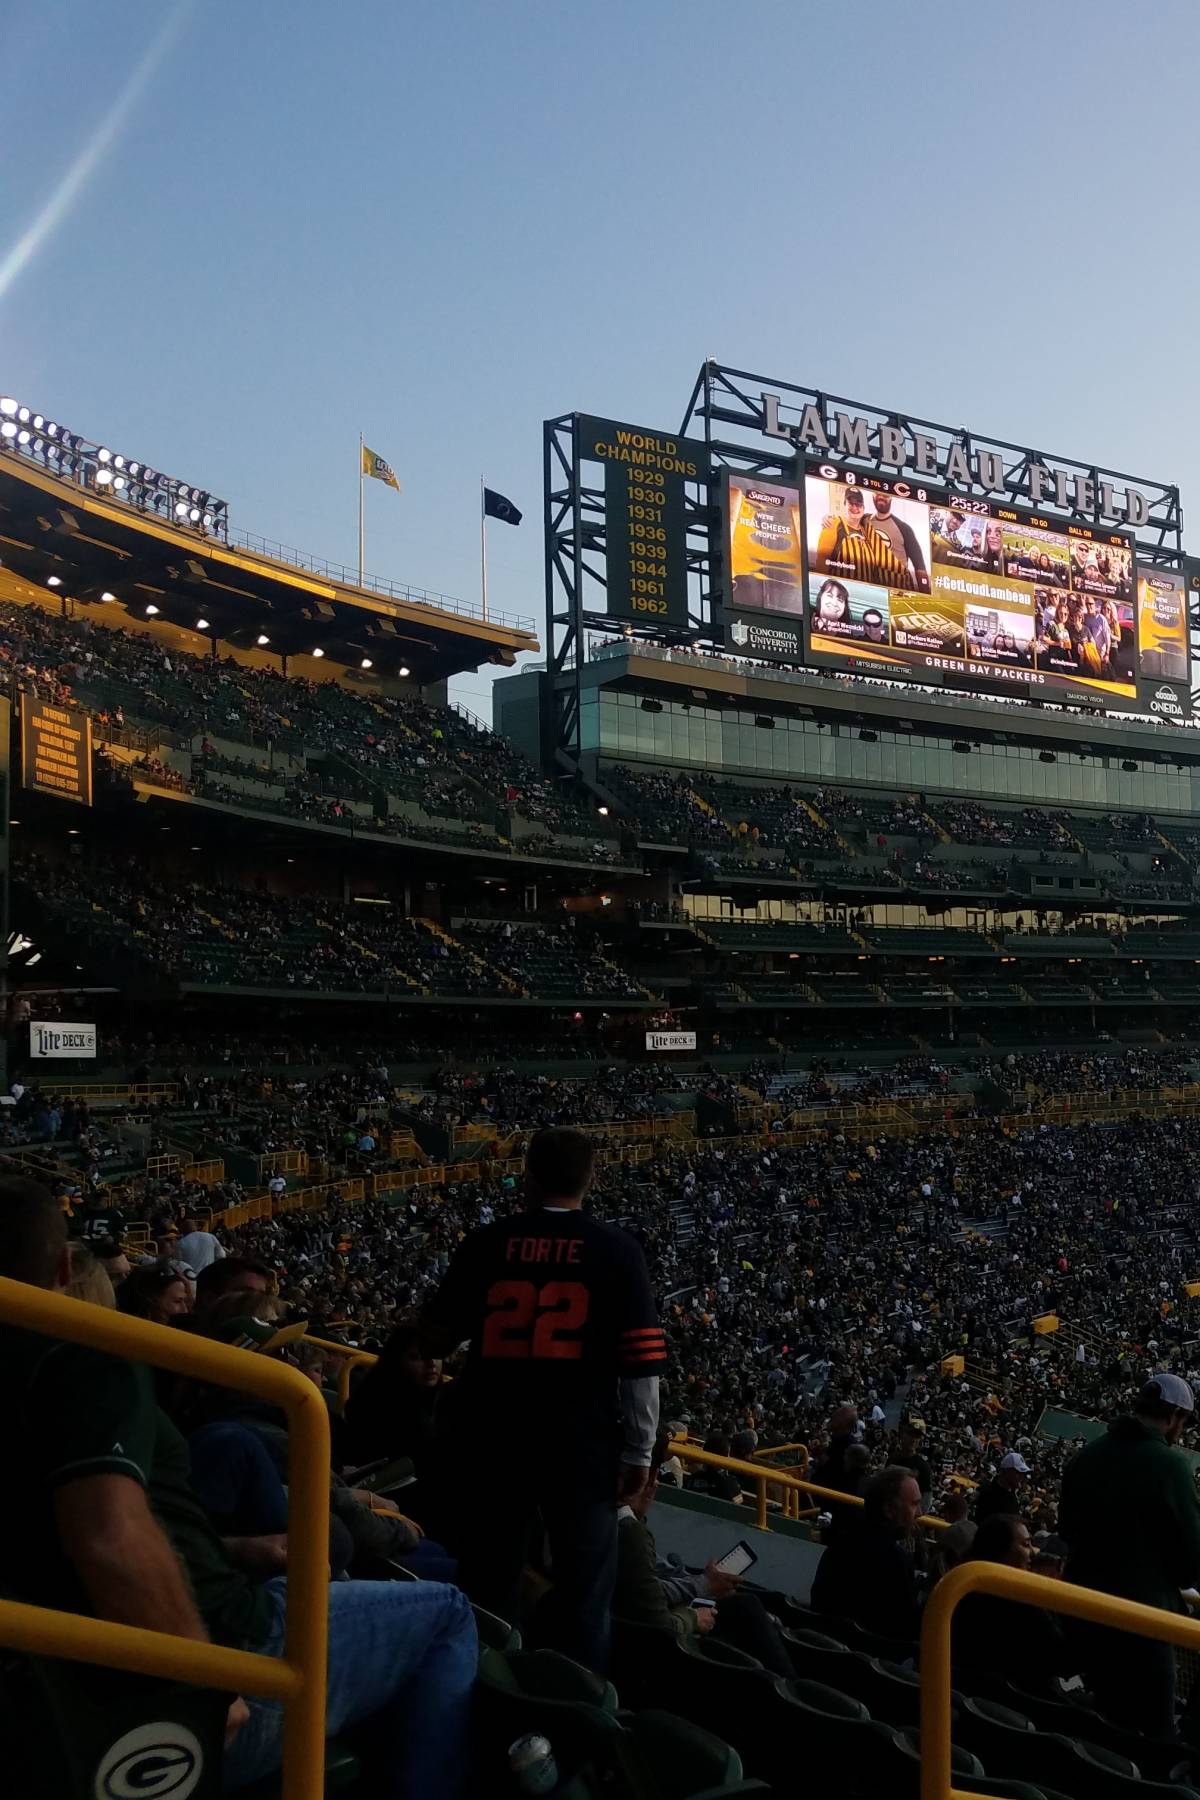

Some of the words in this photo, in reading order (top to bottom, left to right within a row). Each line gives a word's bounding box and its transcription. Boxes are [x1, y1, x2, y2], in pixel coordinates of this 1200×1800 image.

[616, 431, 677, 456] WORLD
[594, 443, 697, 476] CHAMPIONS
[760, 392, 1006, 494] LAMBEAU
[1027, 463, 1150, 527] FIELD
[626, 467, 665, 487] 1929
[845, 471, 856, 485] 0
[626, 486, 666, 506] 1930
[917, 489, 927, 502] 0
[627, 504, 662, 523] 1931
[951, 496, 988, 515] 25:22
[998, 510, 1017, 521] DOWN
[1030, 517, 1039, 526] TO
[1039, 519, 1048, 528] GO
[628, 523, 666, 541] 1936
[740, 517, 760, 529] REAL
[761, 521, 792, 535] CHEESE
[1068, 526, 1080, 536] BALL
[628, 541, 667, 560] 1939
[629, 559, 667, 578] 1944
[629, 578, 665, 596] 1961
[934, 575, 1031, 606] #GetLoudLambeau
[630, 596, 668, 614] 1962
[1158, 605, 1180, 614] CHEESE
[750, 626, 797, 641] CONCORDIA
[750, 634, 798, 649] UNIVERSITY
[855, 660, 886, 670] MITSUBISHI
[886, 665, 912, 674] ELECTRIC
[925, 656, 965, 671] GREEN
[969, 664, 990, 675] BAY
[995, 668, 1045, 684] PACKERS
[1150, 702, 1183, 716] ONEIDA
[38, 1029, 61, 1056] Lite
[62, 1034, 85, 1047] DECK
[651, 1035, 668, 1049] Lite
[506, 1237, 585, 1264] FORTE
[481, 1279, 590, 1359] 22
